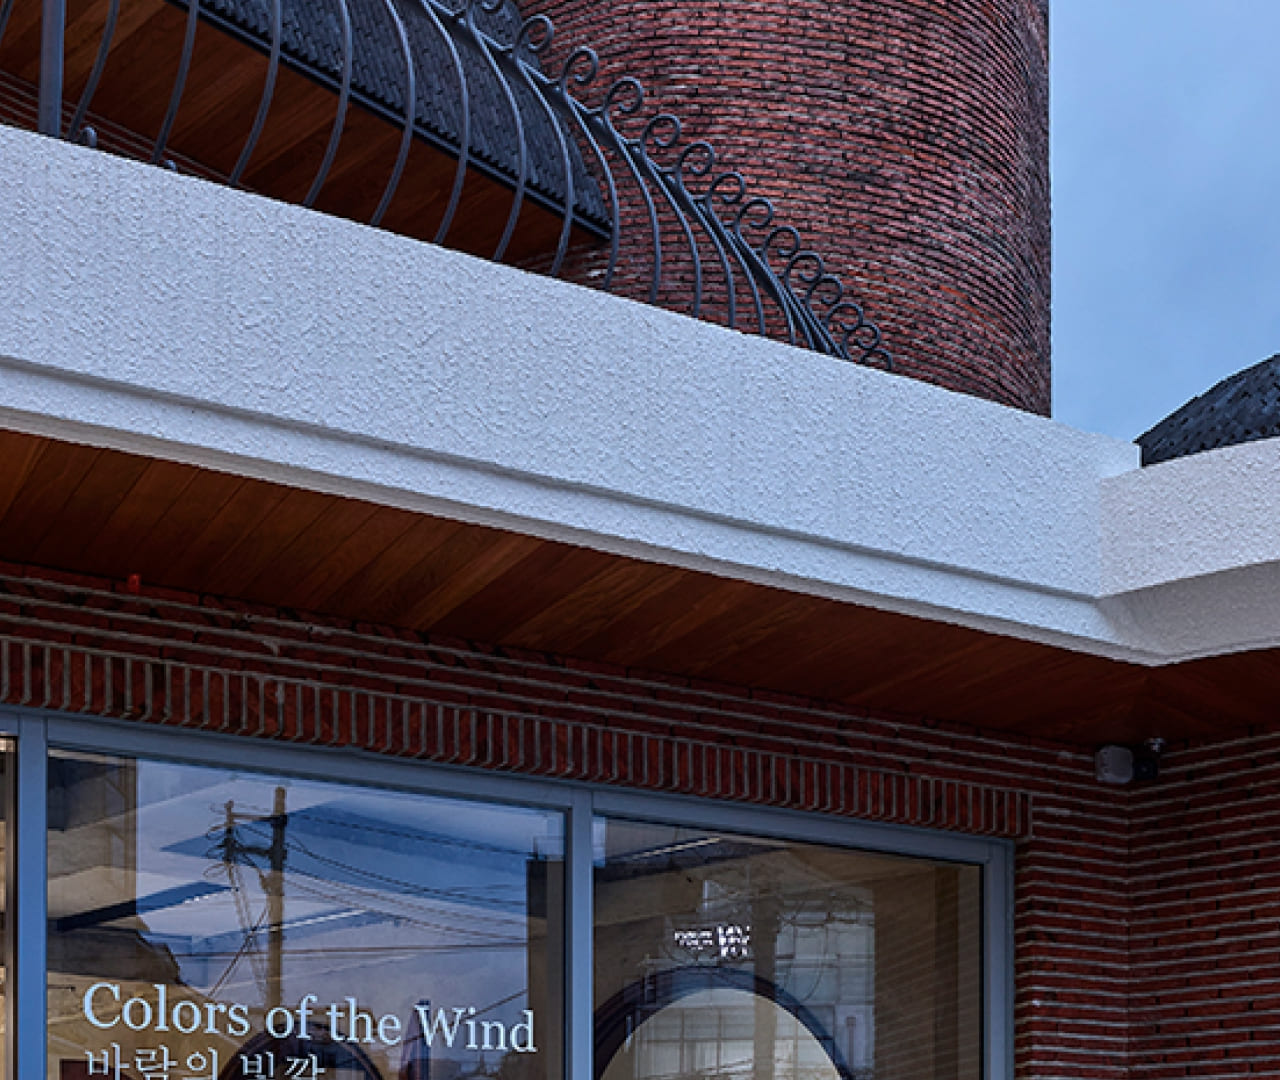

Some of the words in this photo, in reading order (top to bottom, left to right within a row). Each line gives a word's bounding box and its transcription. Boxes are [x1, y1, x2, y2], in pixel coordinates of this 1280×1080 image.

[83, 982, 251, 1037] Colors
[265, 994, 318, 1041] of
[326, 996, 402, 1045] the
[414, 1004, 537, 1053] Wind
